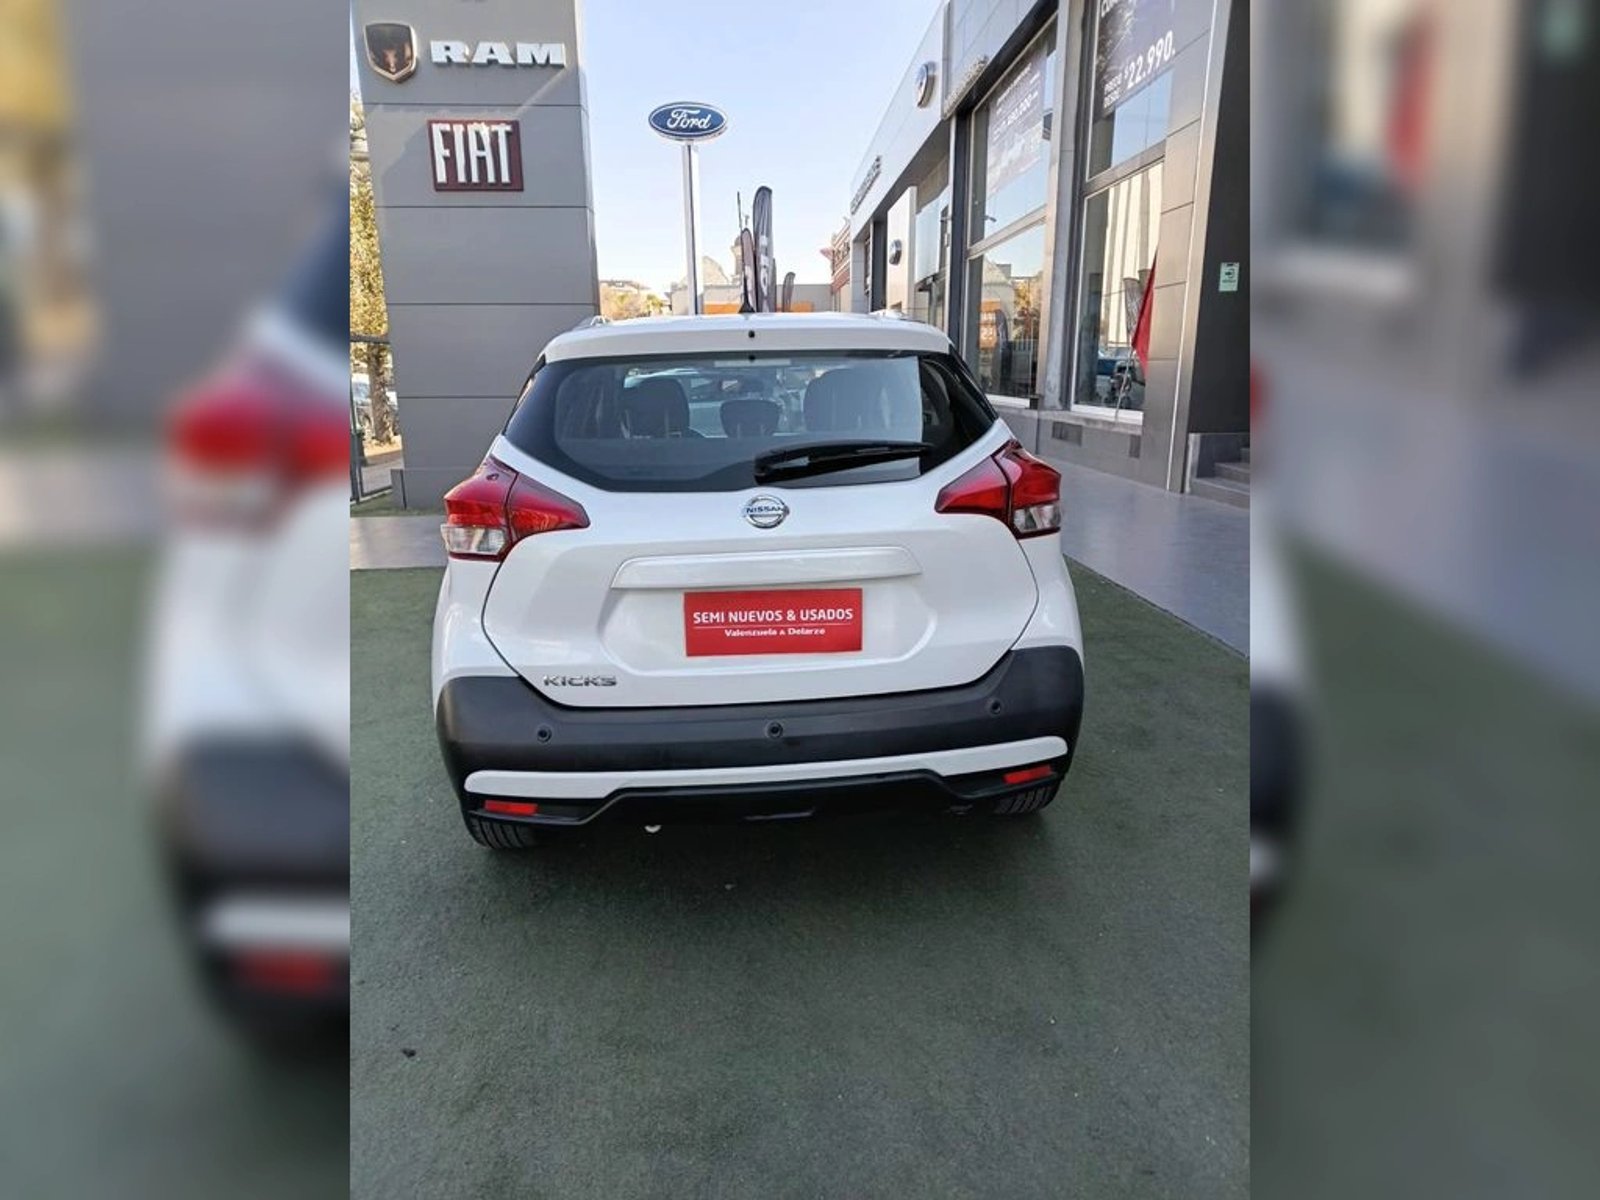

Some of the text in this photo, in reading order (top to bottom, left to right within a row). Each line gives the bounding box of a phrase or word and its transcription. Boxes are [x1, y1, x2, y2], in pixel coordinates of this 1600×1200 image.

[431, 40, 565, 68] RAM
[666, 108, 712, 129] Ford
[431, 123, 513, 185] FIAT
[746, 505, 784, 513] NISSAN
[693, 608, 853, 624] SEMI NUEVOS & USADOS
[724, 628, 777, 637] Valenzuela
[543, 674, 617, 687] KICKS
